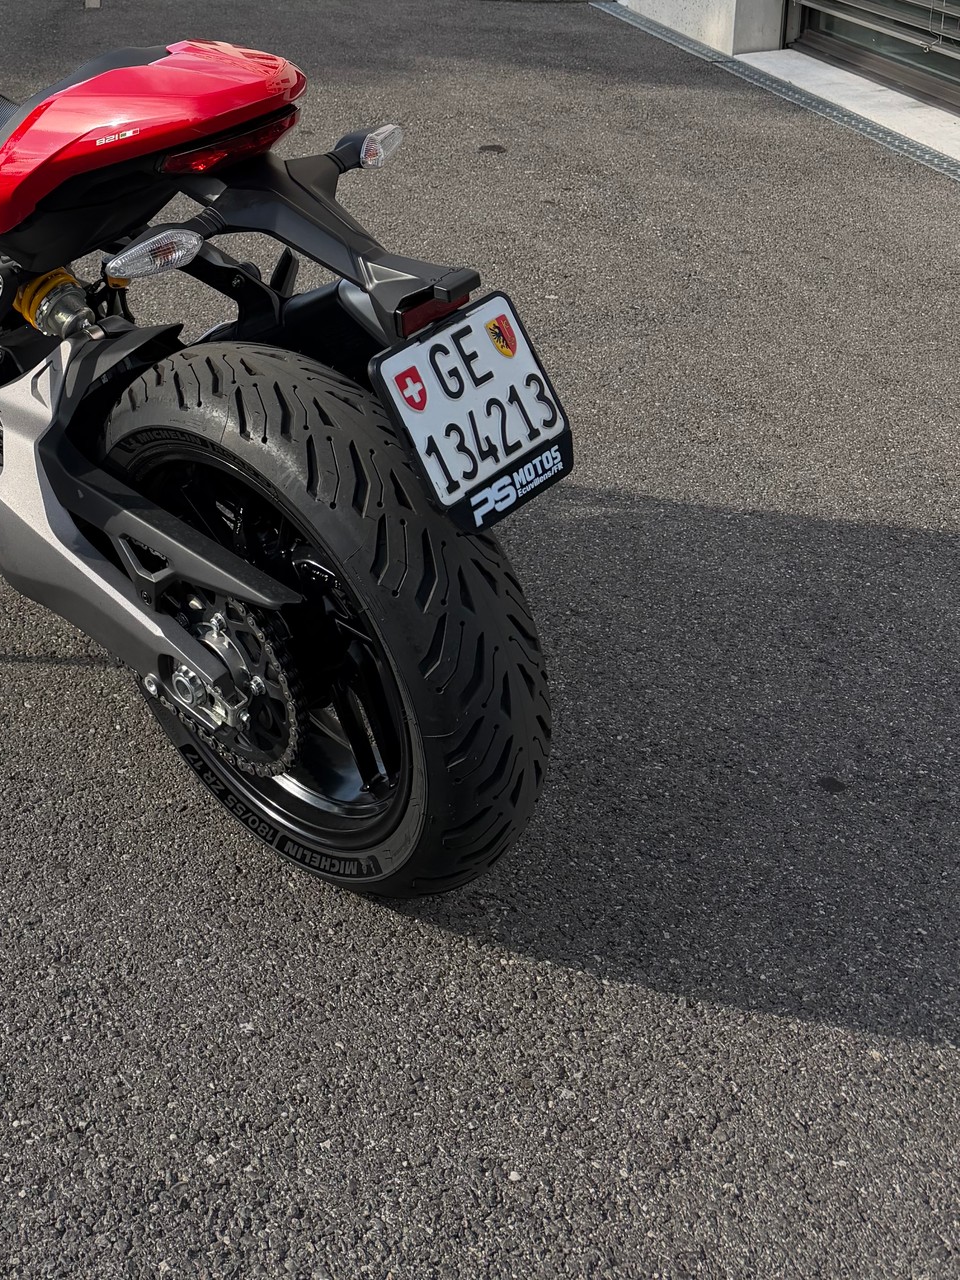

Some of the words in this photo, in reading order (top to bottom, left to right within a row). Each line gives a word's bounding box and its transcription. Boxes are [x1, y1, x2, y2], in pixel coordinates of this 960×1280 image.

[95, 133, 119, 146] 821
[429, 325, 495, 400] GE
[137, 428, 202, 446] MICHELIN
[425, 373, 558, 495] 134213
[470, 475, 517, 528] PS
[512, 444, 562, 490] MOTOS
[184, 752, 205, 770] 17
[202, 770, 226, 795] ZR
[223, 794, 274, 841] 180/55
[283, 841, 359, 875] MICHELIN
